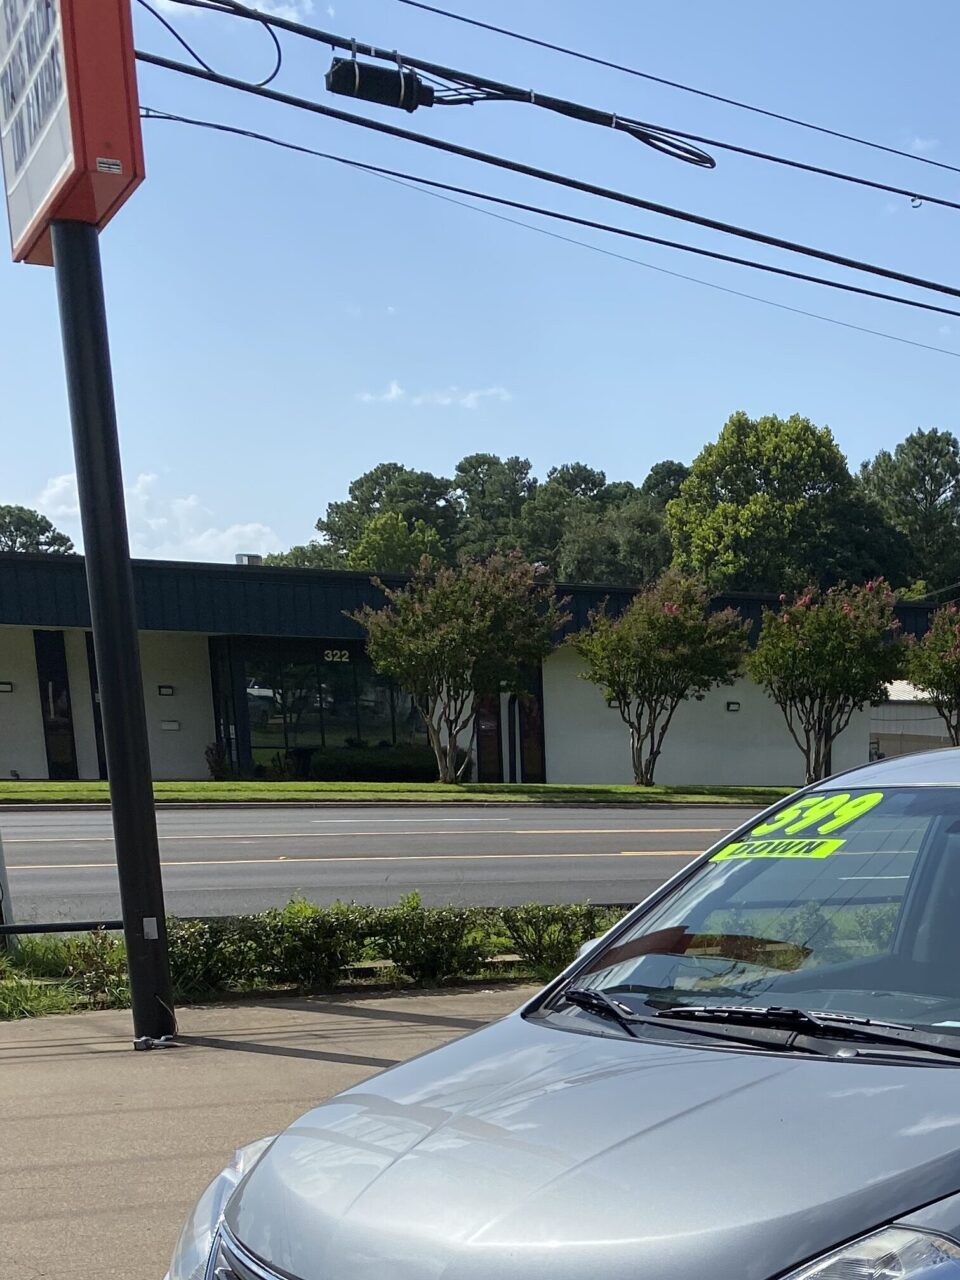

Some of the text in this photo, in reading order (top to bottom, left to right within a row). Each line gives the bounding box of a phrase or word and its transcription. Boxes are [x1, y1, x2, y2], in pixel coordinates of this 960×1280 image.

[323, 649, 350, 662] 322
[751, 792, 884, 837] 599
[727, 840, 827, 856] DOWN
